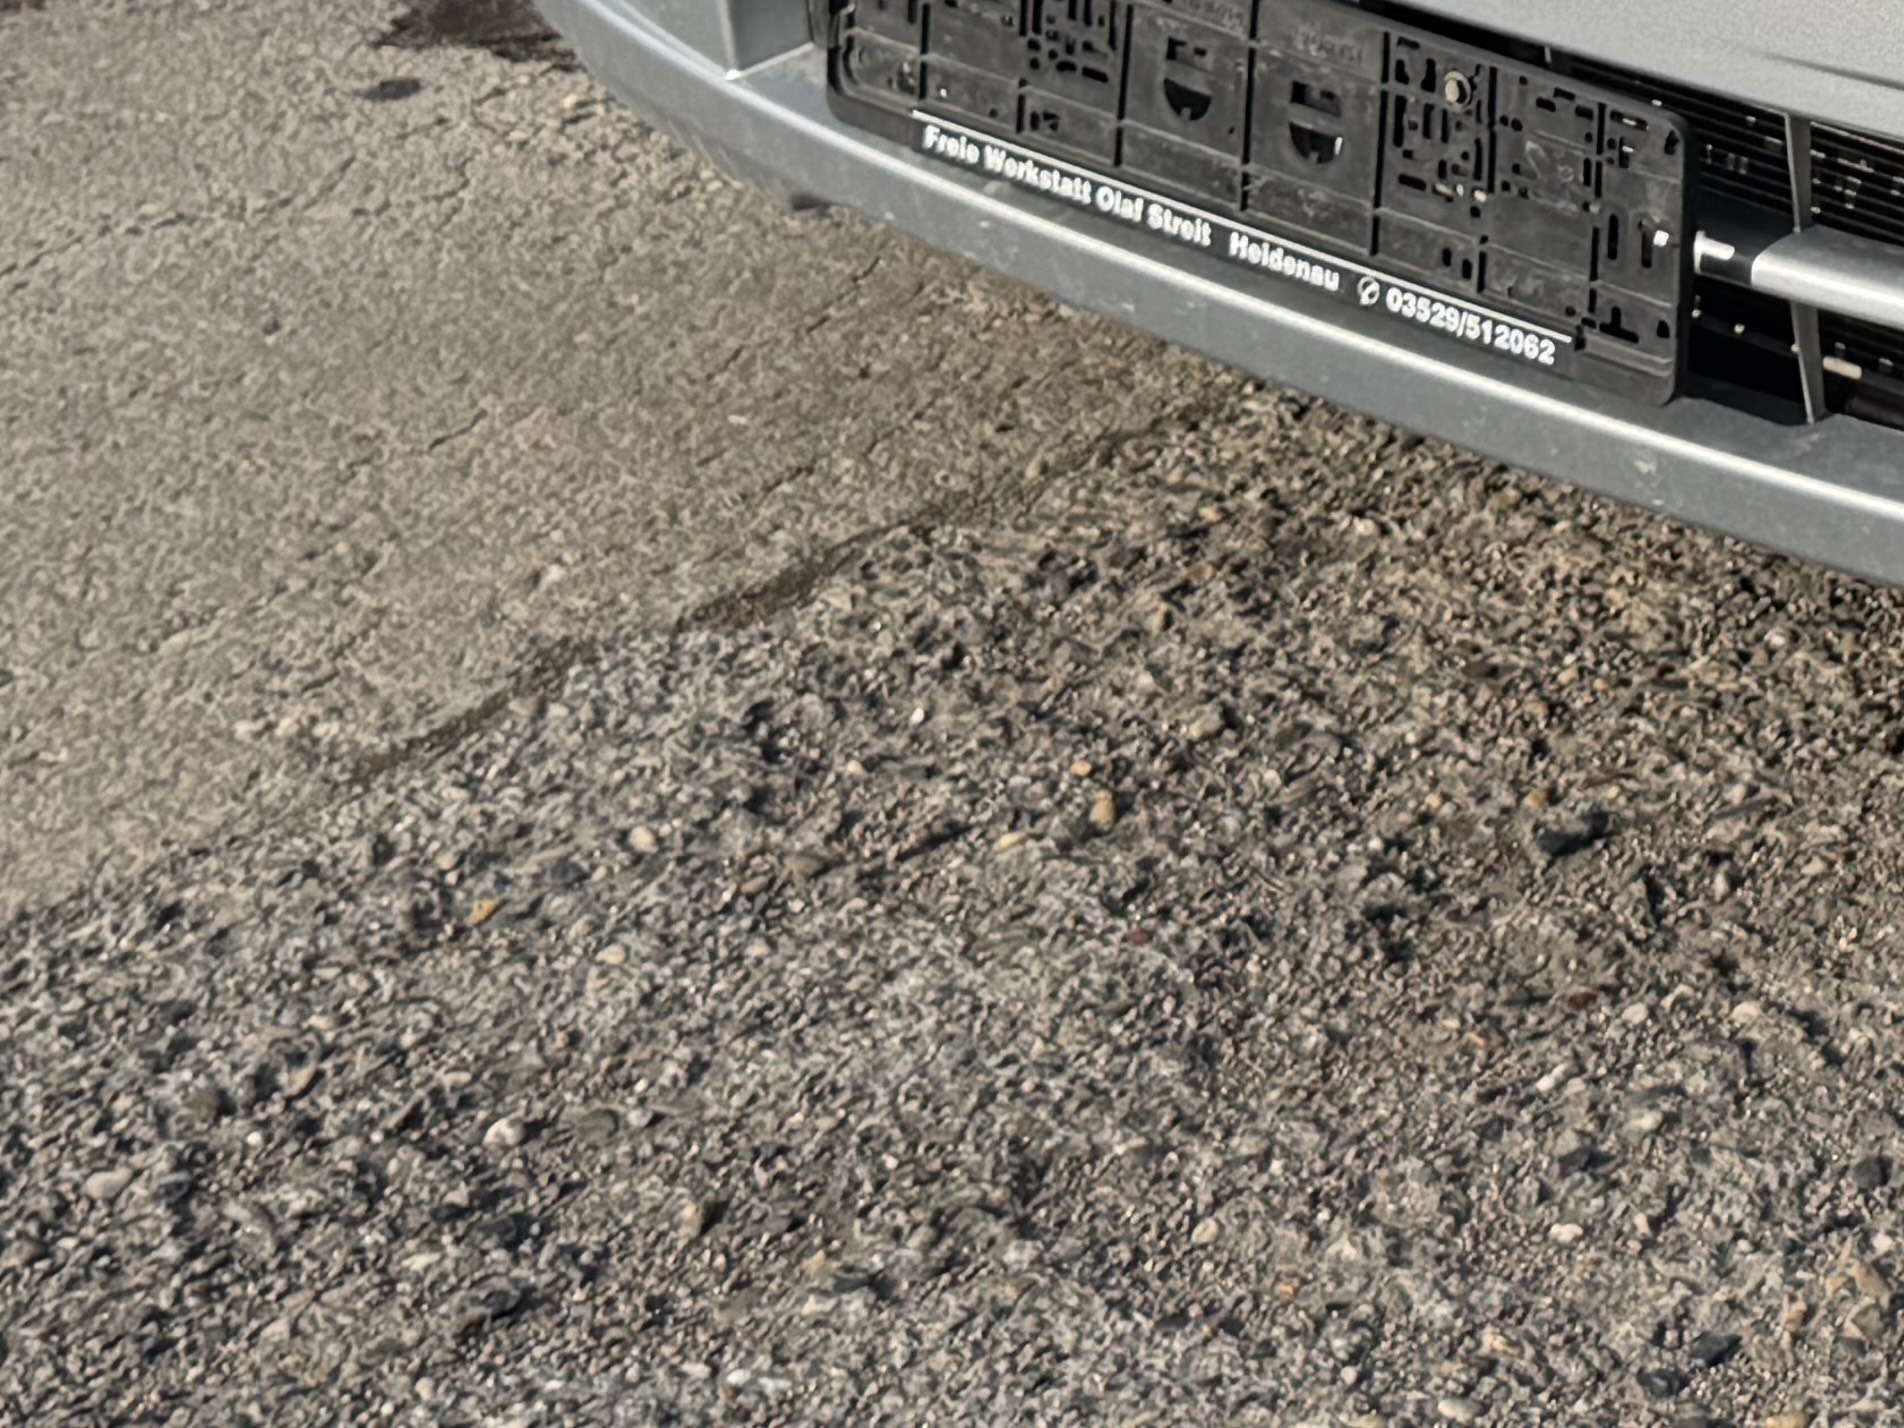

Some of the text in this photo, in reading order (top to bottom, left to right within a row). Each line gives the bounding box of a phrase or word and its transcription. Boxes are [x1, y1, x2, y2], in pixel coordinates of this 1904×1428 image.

[922, 124, 1557, 366] Freie Werkstatt Olaf Streit Heidenau 03529/512062
